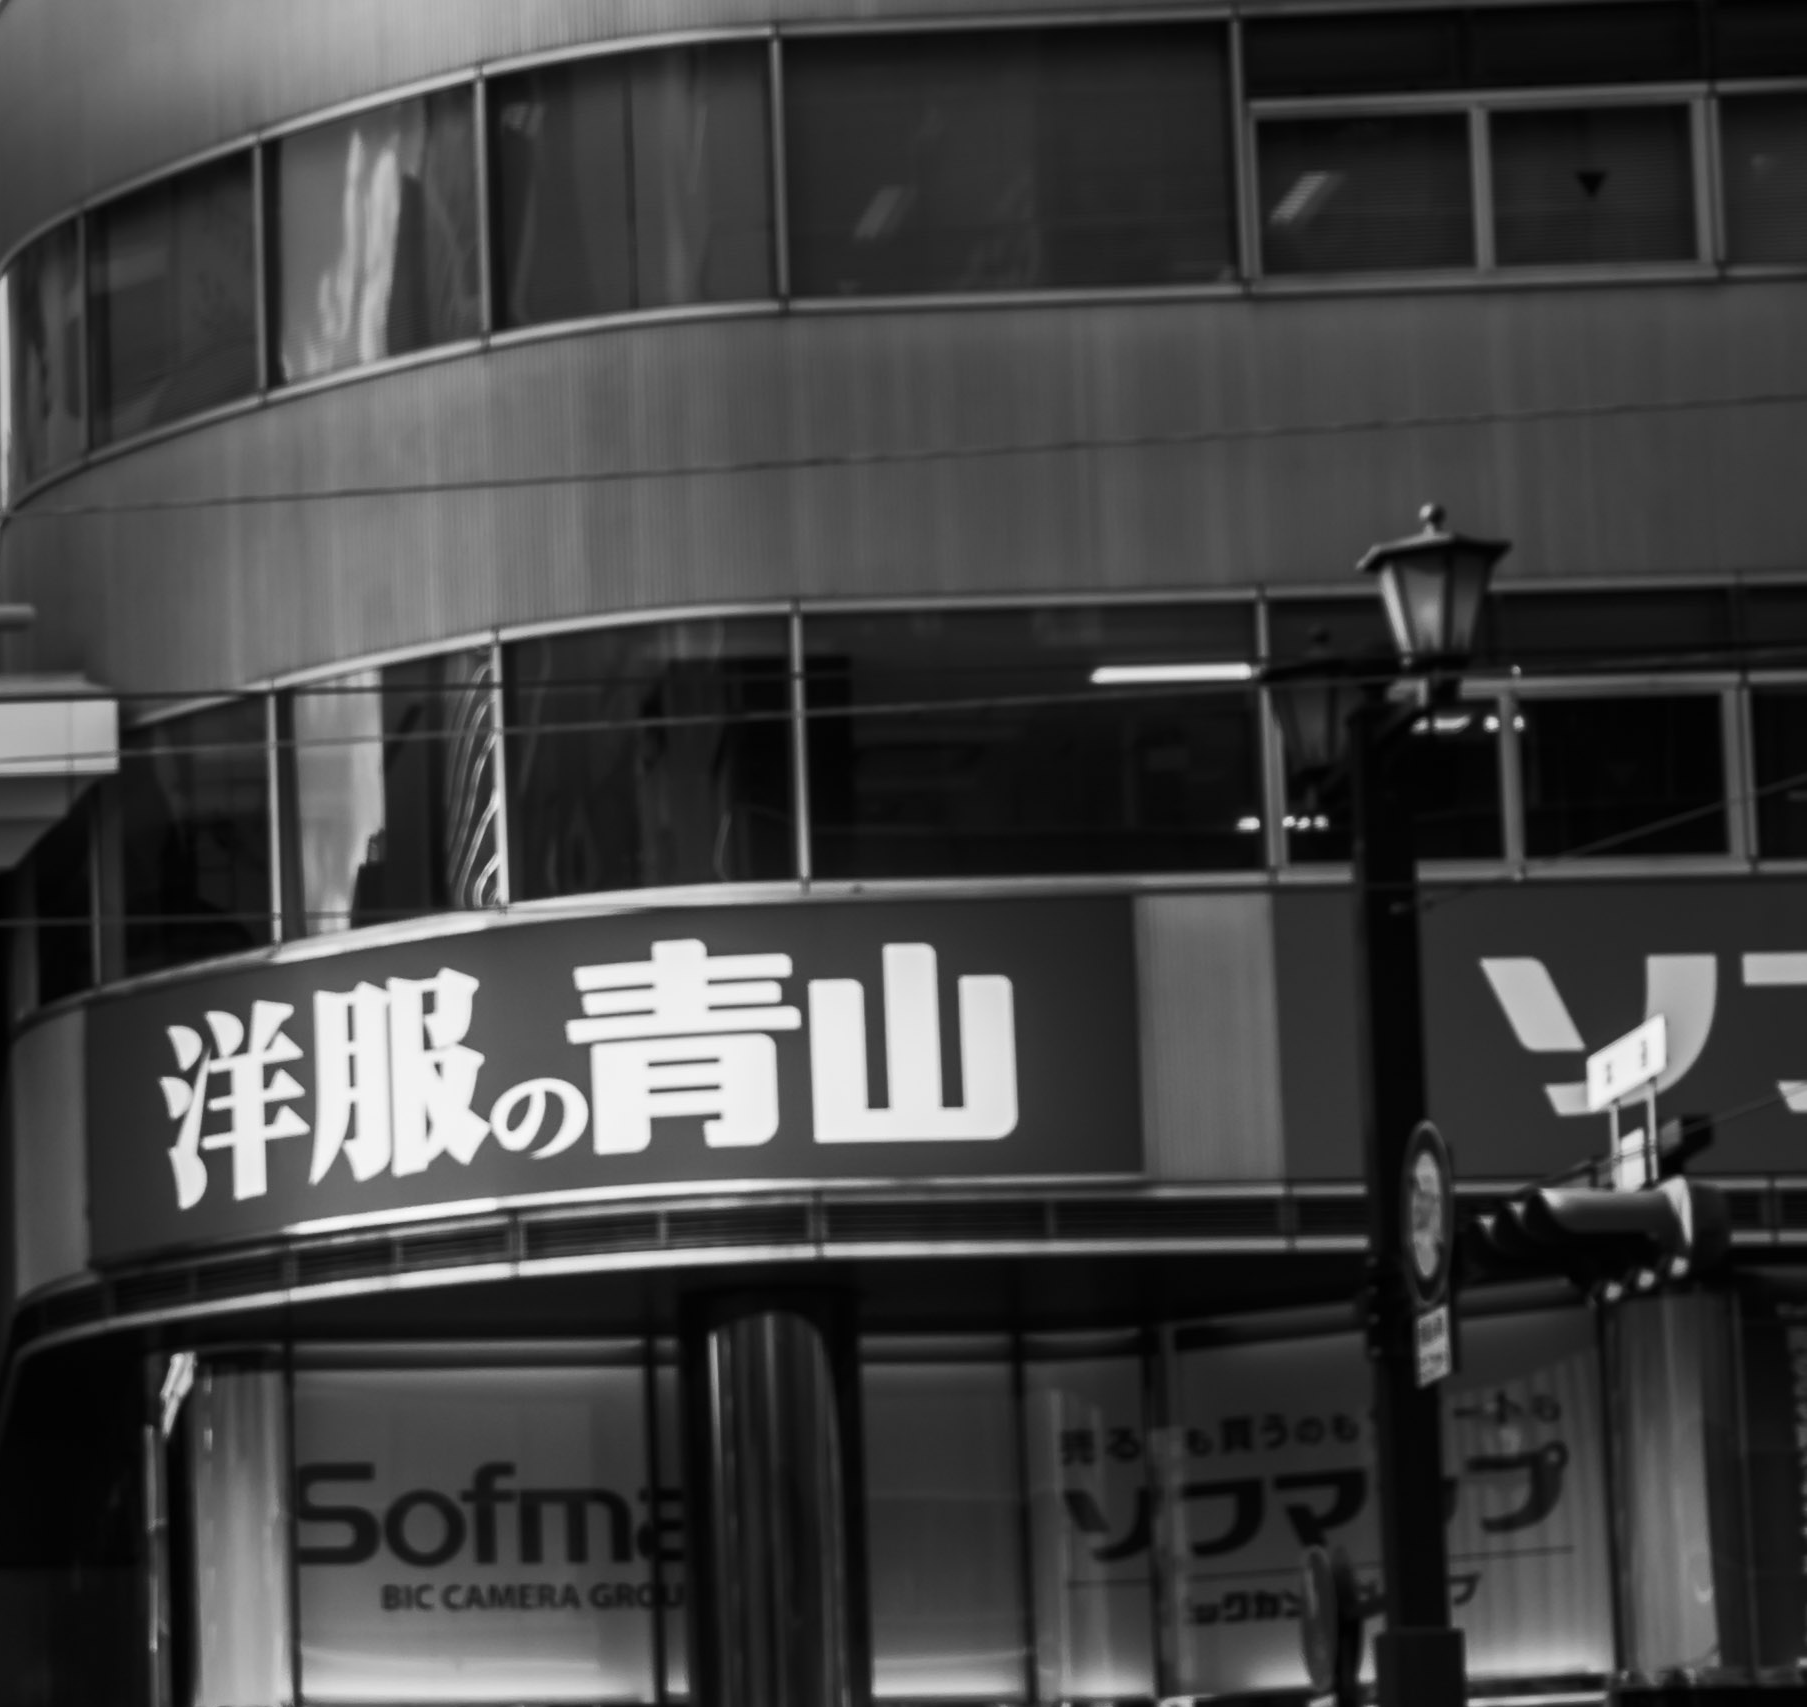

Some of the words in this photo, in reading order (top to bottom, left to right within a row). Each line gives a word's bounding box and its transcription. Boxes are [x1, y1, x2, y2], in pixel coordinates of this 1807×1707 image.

[160, 937, 1020, 1211] 洋服の青山
[381, 1584, 434, 1612] BIC
[441, 1583, 581, 1611] CAMERA
